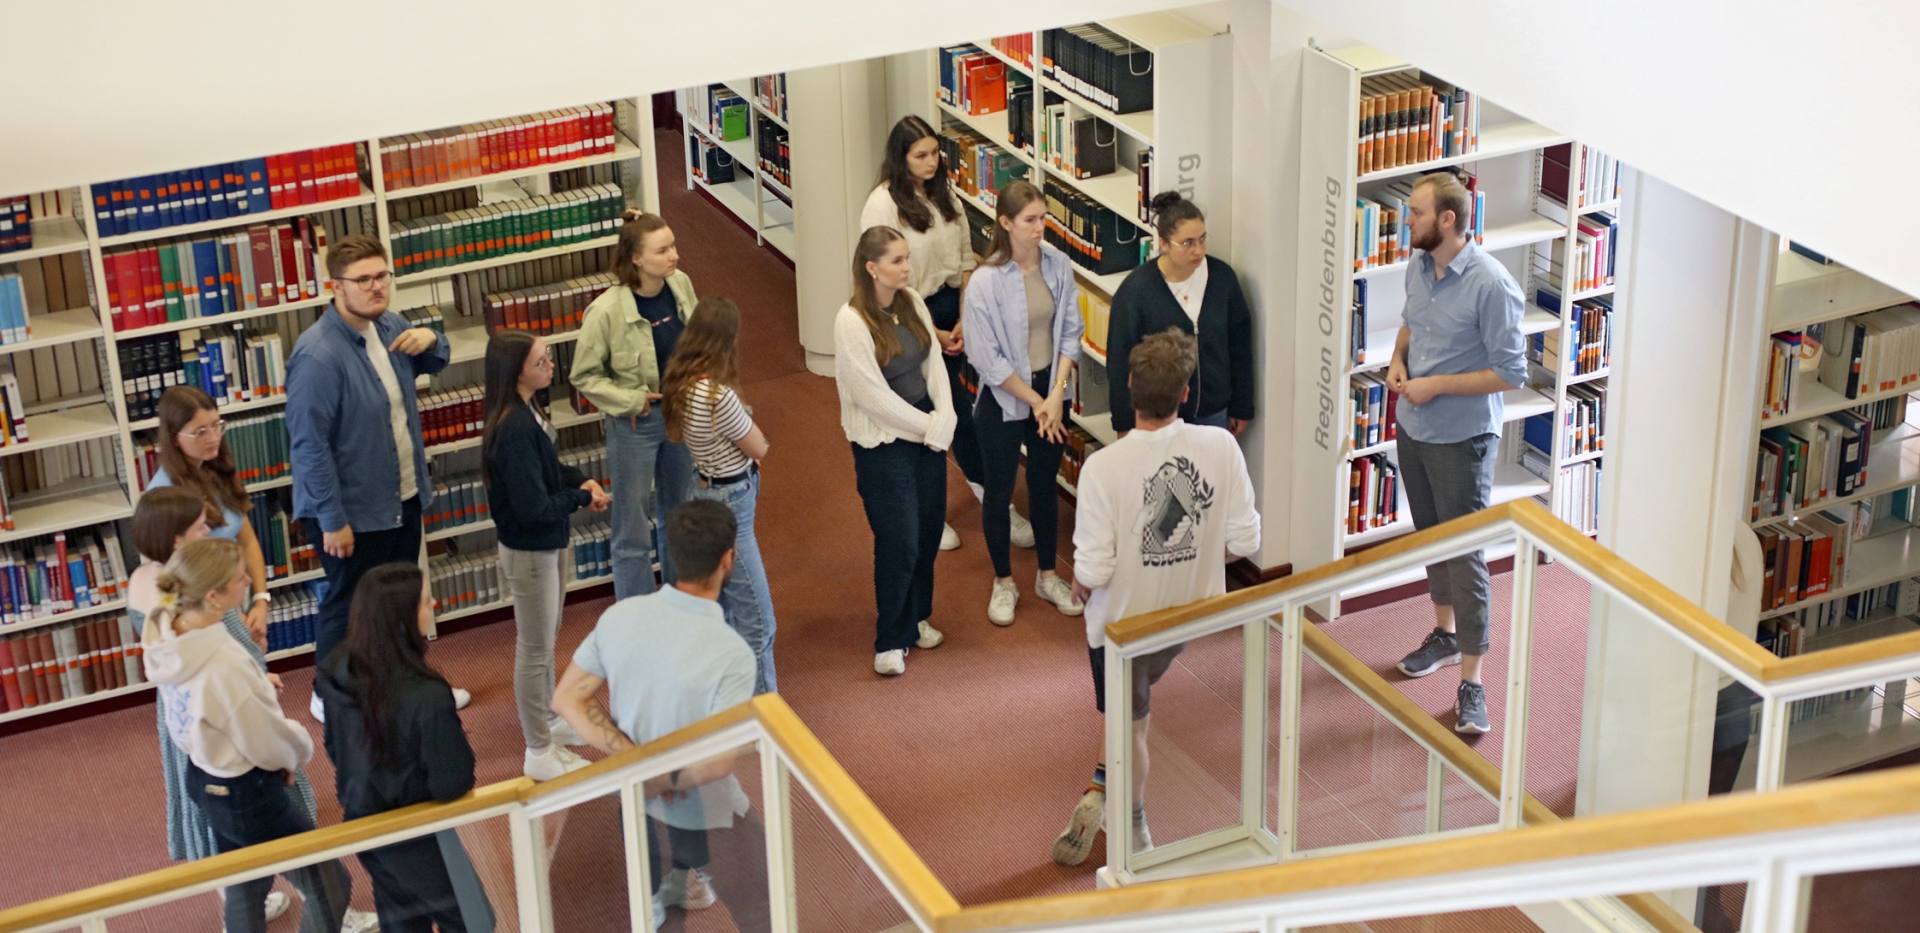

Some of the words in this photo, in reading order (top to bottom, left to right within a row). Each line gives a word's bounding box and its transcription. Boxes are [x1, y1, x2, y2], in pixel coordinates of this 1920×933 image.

[1178, 153, 1201, 201] urg
[1318, 176, 1342, 337] Oldenburg
[1314, 348, 1335, 450] Region
